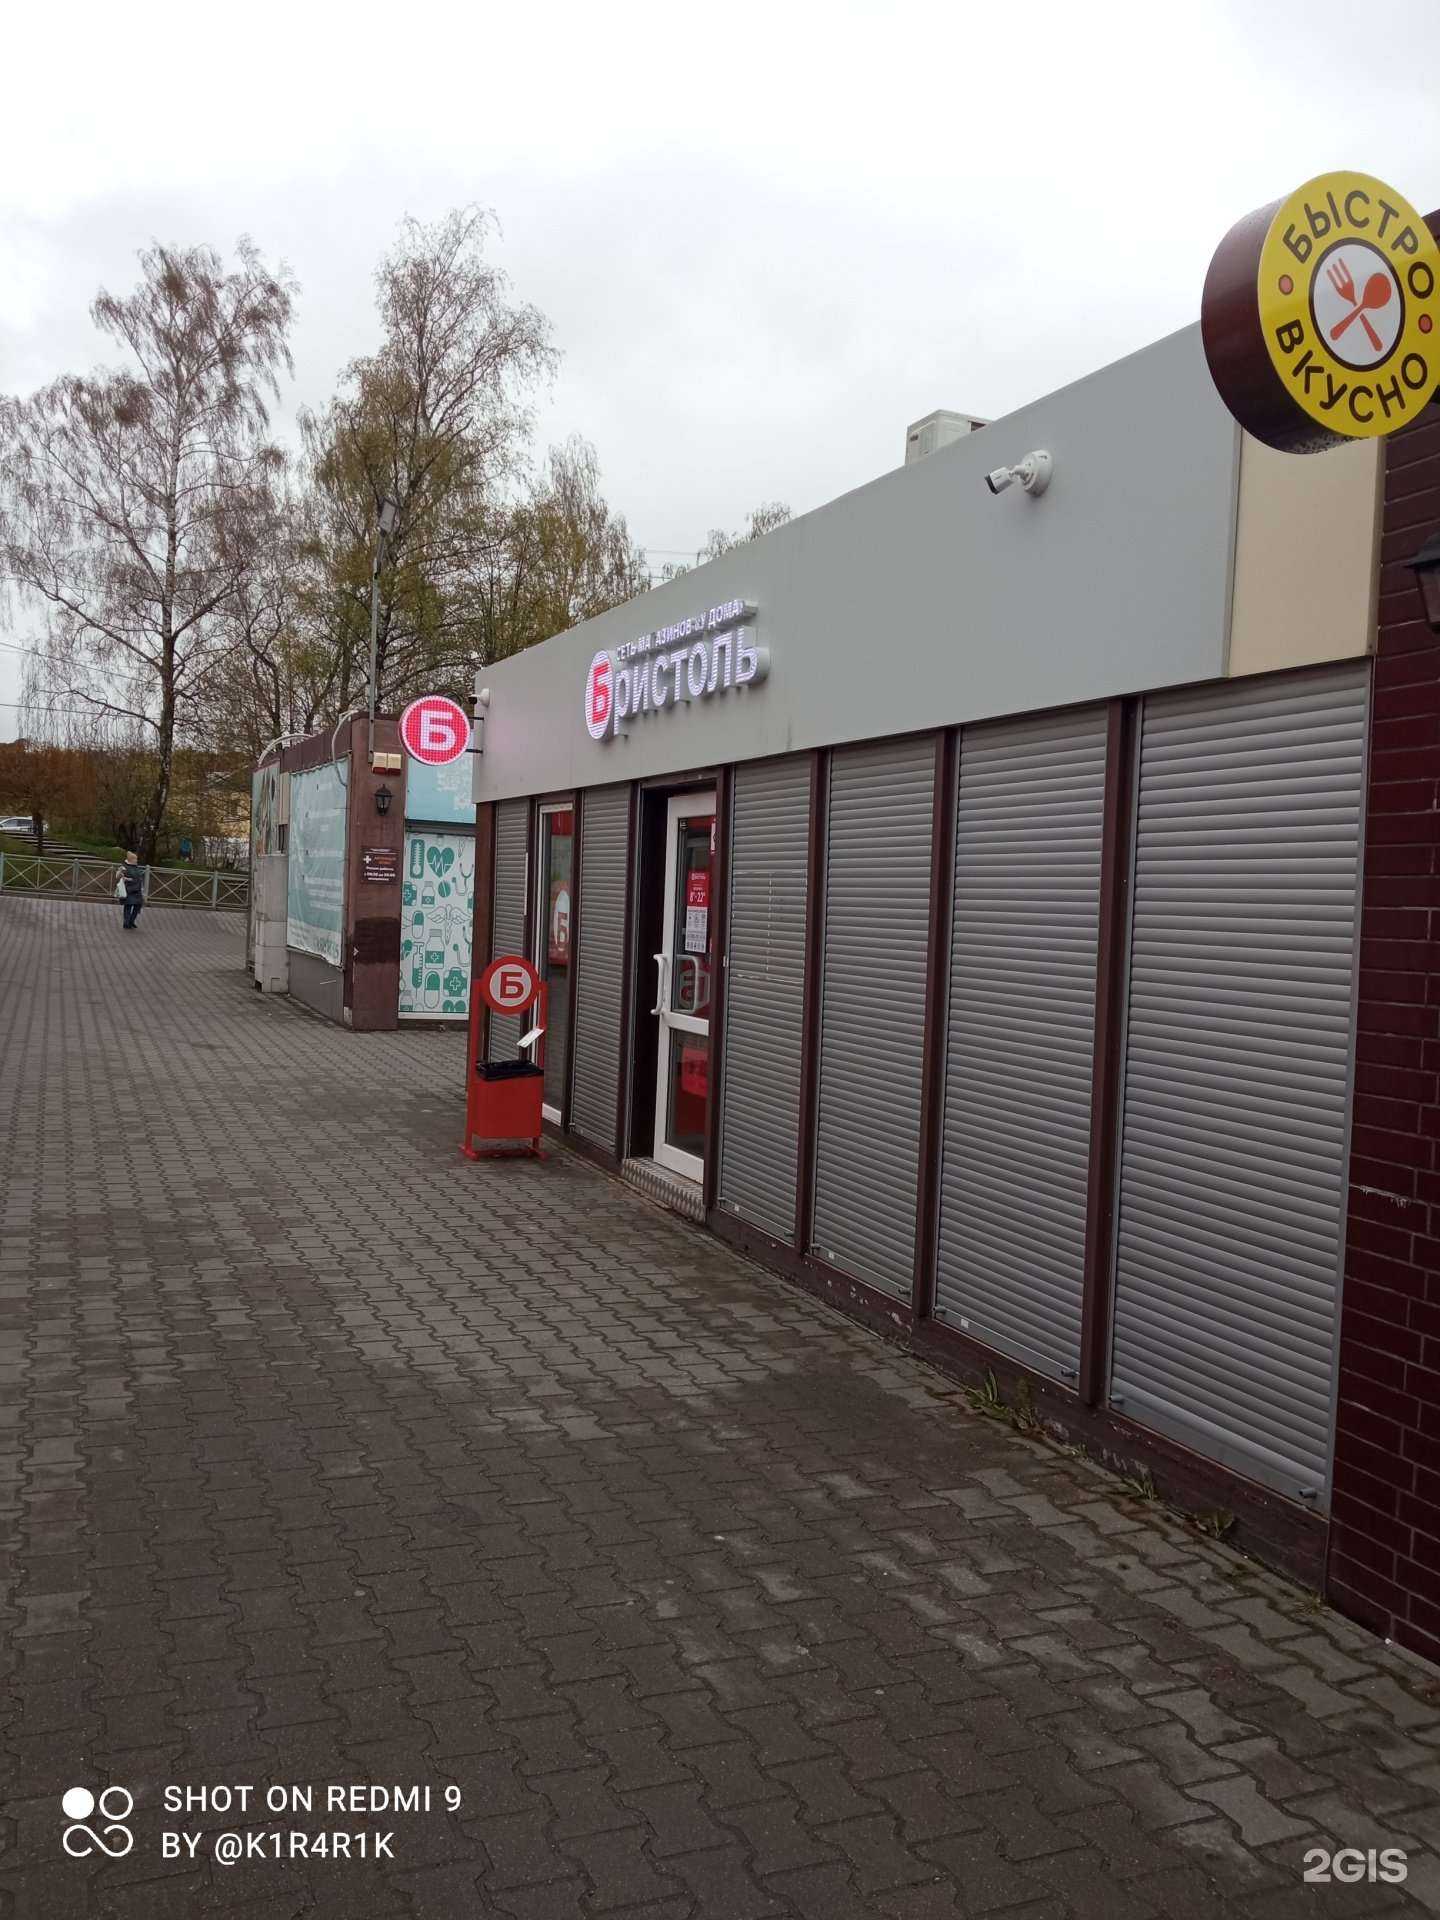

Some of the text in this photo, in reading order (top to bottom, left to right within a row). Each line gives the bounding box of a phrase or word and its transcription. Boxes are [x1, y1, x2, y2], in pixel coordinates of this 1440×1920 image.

[1282, 190, 1434, 299] БЫСТРО
[1275, 318, 1428, 423] ВКУСНО
[420, 709, 456, 750] Б
[499, 972, 525, 998] Б
